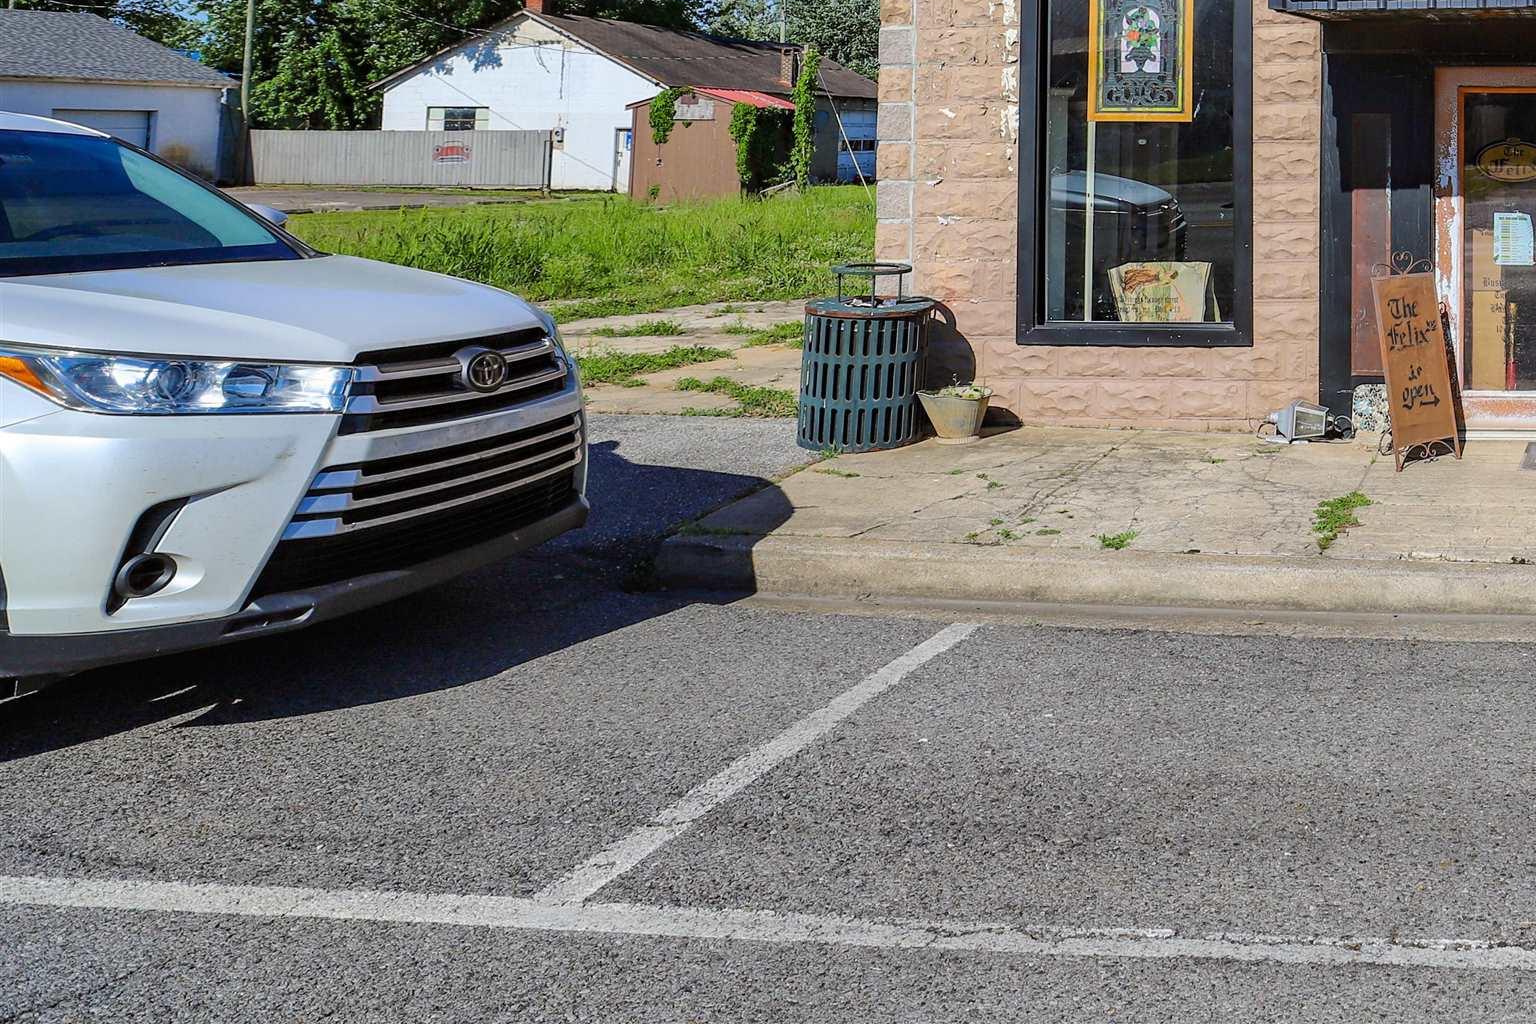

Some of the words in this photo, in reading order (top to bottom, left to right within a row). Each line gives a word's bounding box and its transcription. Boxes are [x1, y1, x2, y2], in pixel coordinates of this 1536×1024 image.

[1503, 145, 1525, 160] The
[1387, 298, 1419, 319] The
[1387, 321, 1430, 348] Felix
[1402, 384, 1436, 410] open
